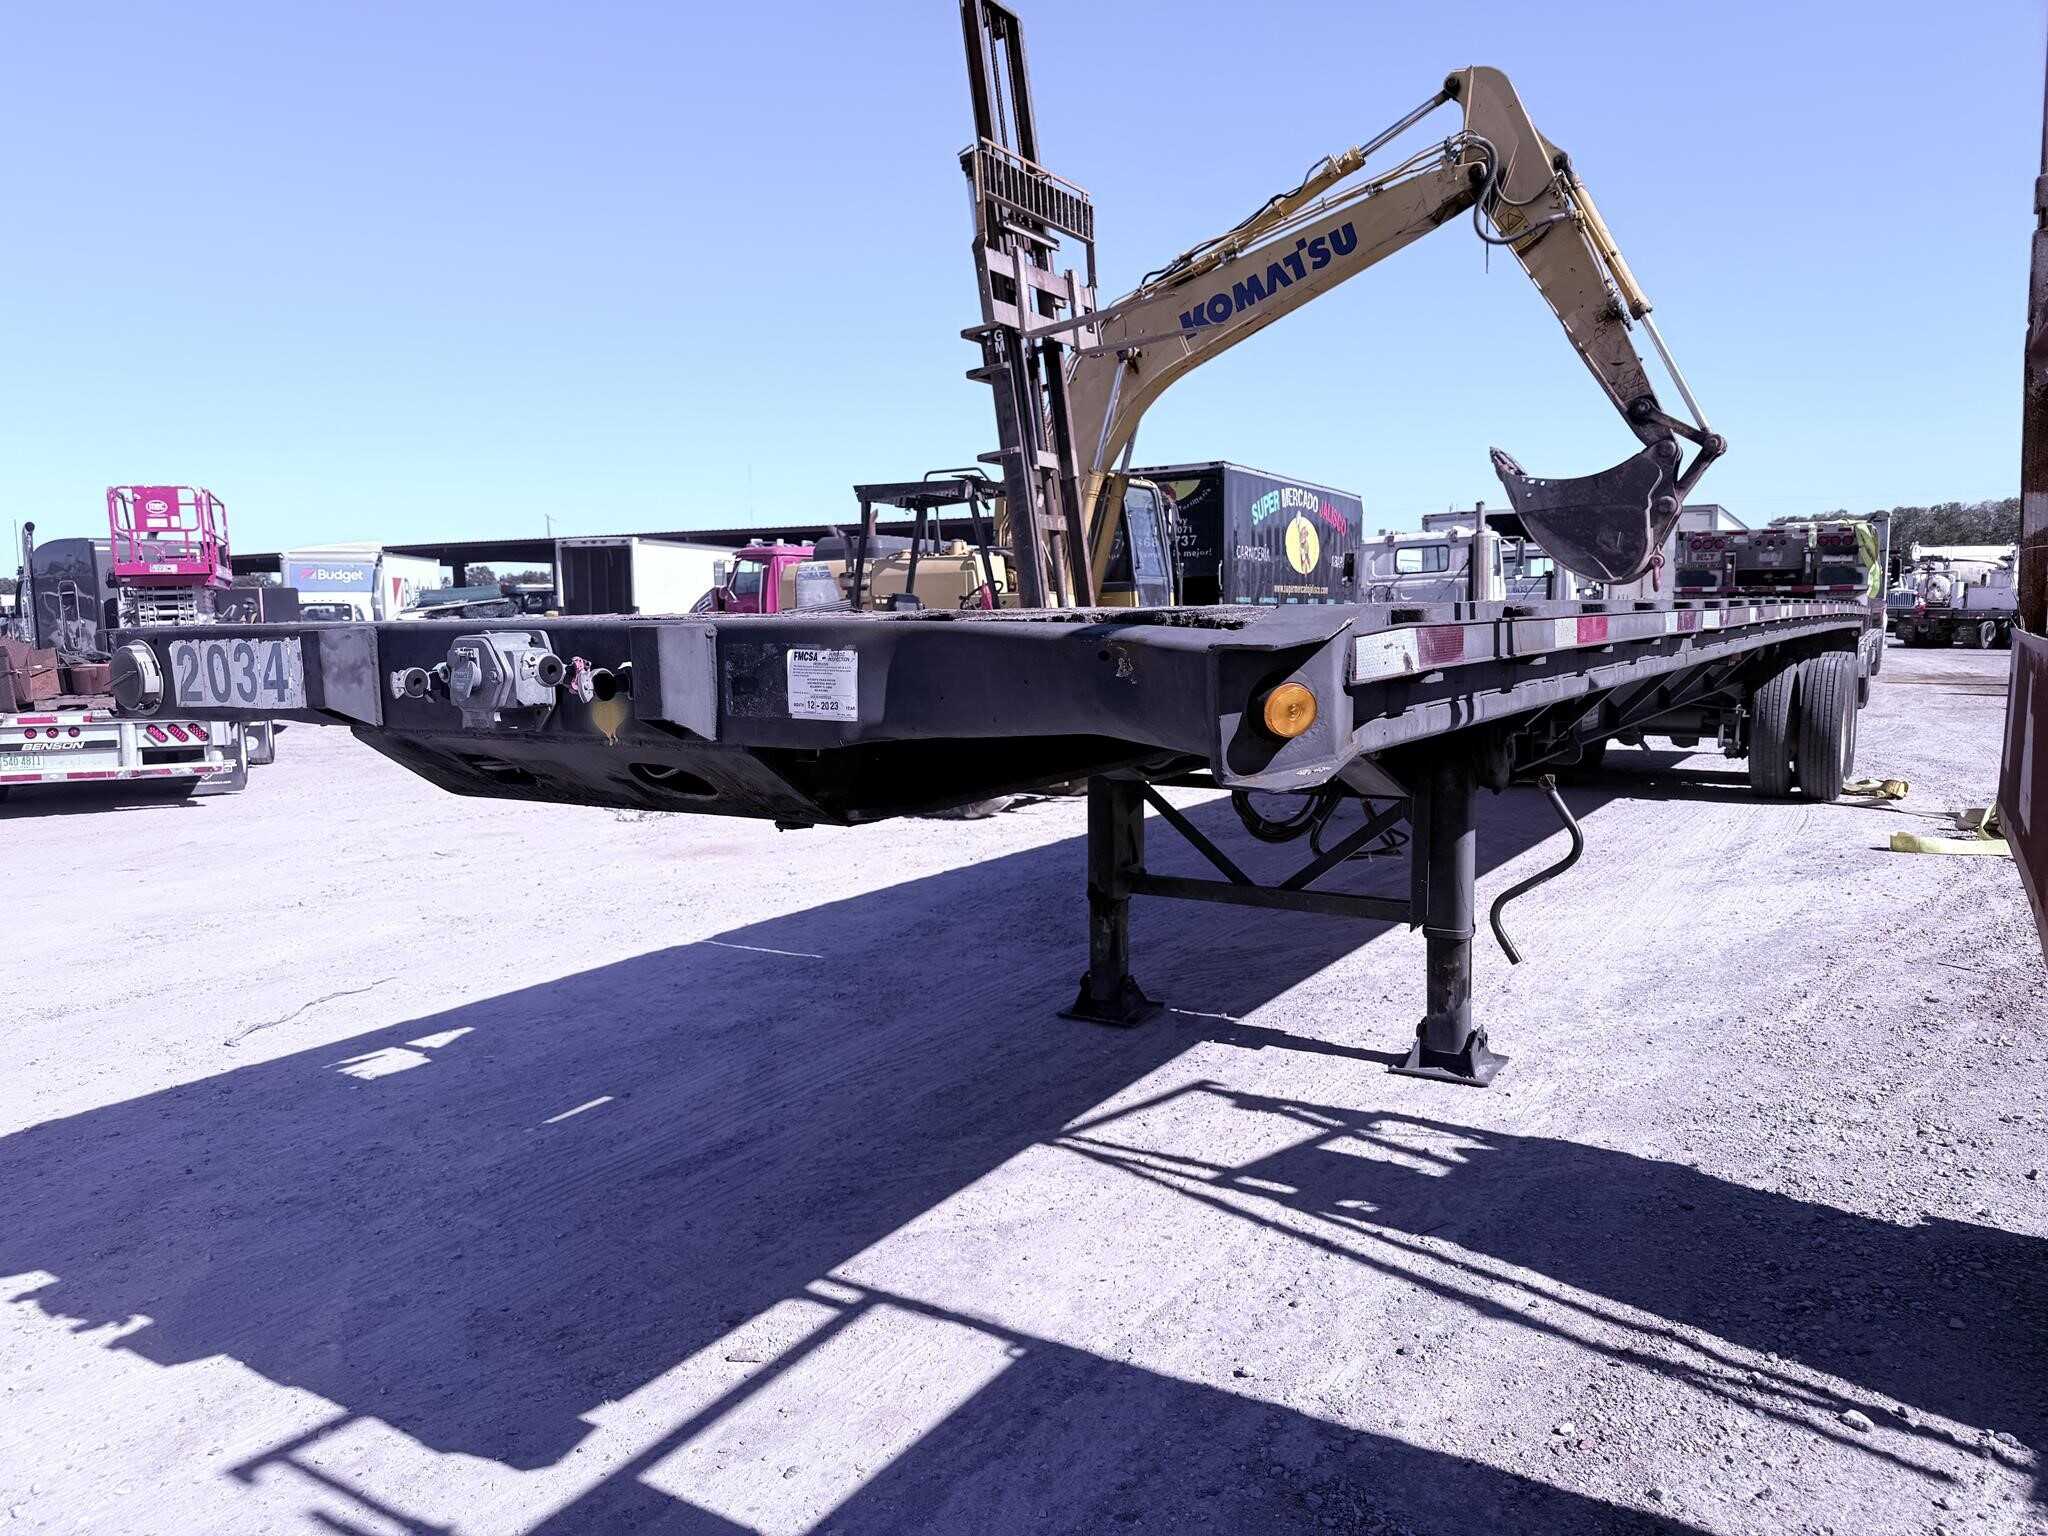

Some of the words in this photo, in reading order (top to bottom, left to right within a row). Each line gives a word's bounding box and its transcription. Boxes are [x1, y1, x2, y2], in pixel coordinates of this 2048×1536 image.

[1179, 222, 1358, 340] KOMATSU
[1251, 490, 1280, 525] SUPER
[1281, 487, 1319, 513] MERCADO
[1319, 500, 1348, 537] JALISCO
[318, 568, 364, 583] Budget
[793, 651, 818, 662] FMCSA
[177, 643, 289, 703] 2034
[21, 741, 85, 751] BENSON
